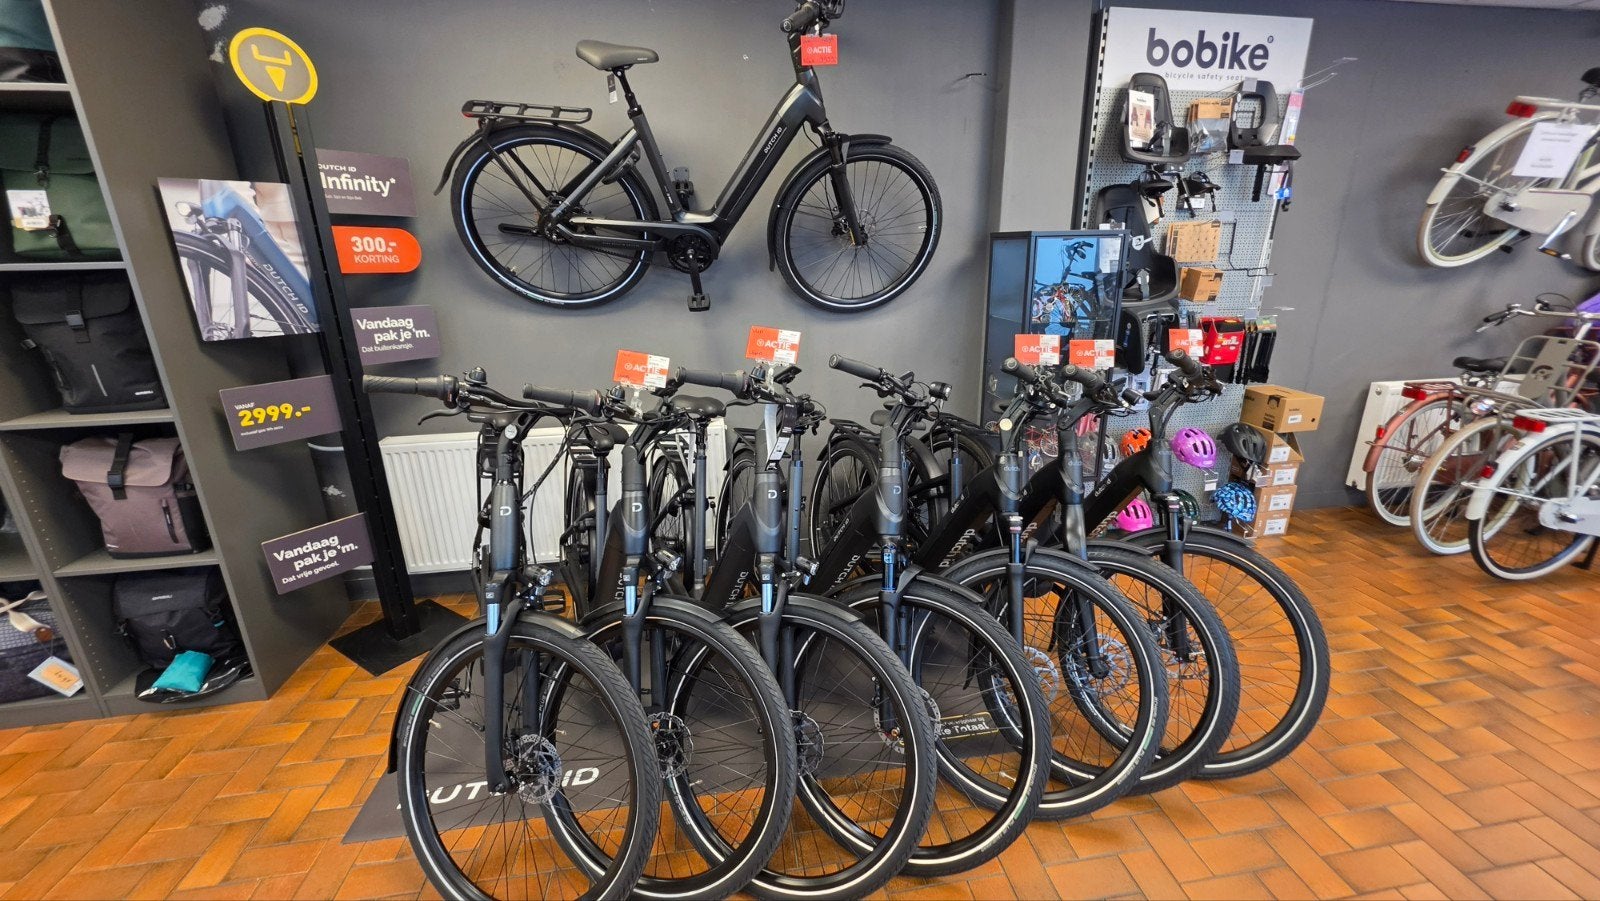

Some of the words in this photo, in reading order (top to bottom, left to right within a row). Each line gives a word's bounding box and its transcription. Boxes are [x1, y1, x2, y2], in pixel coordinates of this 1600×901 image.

[812, 46, 833, 54] ACTIE
[1165, 72, 1194, 80] bicycle
[1197, 73, 1222, 81] safety
[763, 133, 779, 154] DUTCH
[351, 236, 397, 253] 300.-
[354, 254, 400, 264] KORTING
[262, 263, 300, 301] DUTCH
[296, 303, 309, 314] ID
[356, 317, 414, 330] Vandaag
[374, 330, 399, 345] pak
[399, 329, 412, 342] je
[764, 340, 792, 351] ACTIE
[1028, 346, 1053, 354] ACTIE
[1083, 349, 1107, 357] ACTIE
[234, 402, 255, 410] VANAF
[238, 403, 311, 427] 2999.-
[273, 535, 339, 562] Vandaag
[293, 553, 322, 571] pak
[323, 549, 337, 562] je
[282, 575, 297, 584] Dat
[297, 569, 313, 578] vrije
[833, 555, 860, 583] DUTCH
[729, 571, 750, 600] DUTCH
[952, 721, 989, 733] Totaal
[562, 767, 600, 787] ID
